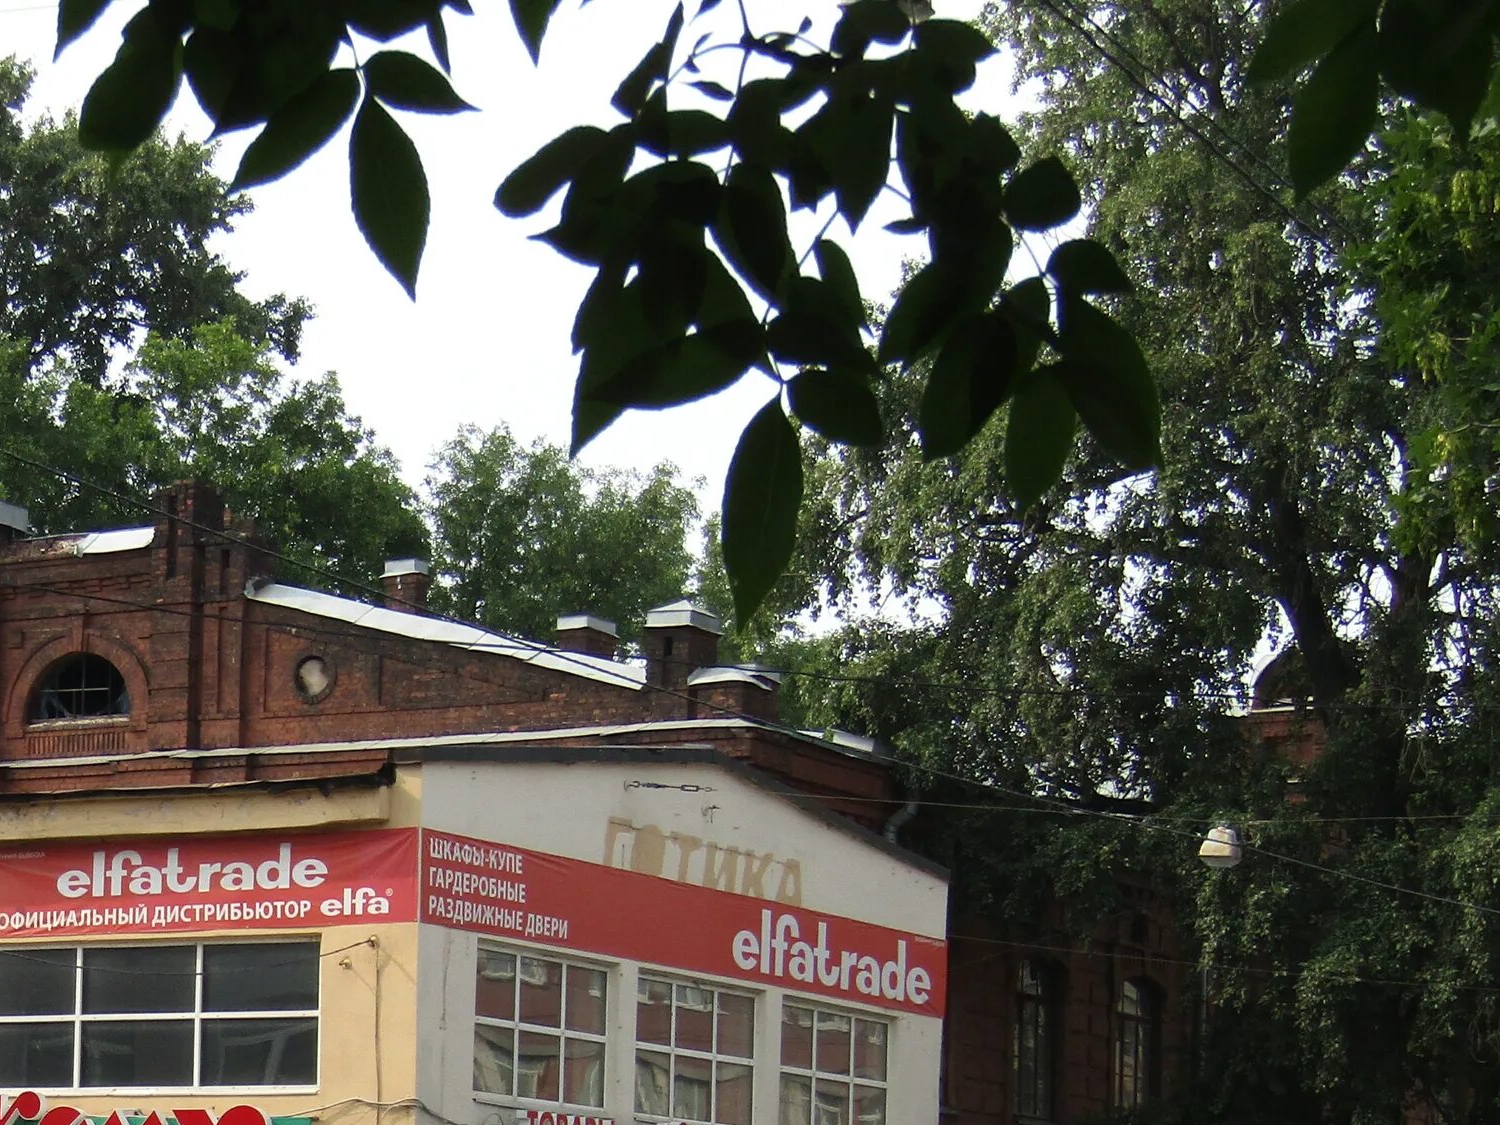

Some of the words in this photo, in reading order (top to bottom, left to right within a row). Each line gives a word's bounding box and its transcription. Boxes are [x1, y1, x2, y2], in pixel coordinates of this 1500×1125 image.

[56, 842, 328, 898] elfatrade
[429, 837, 523, 875] ШКАФЫ-КУПЕ
[429, 866, 526, 903] ГАРДЕРОБНЫЕ
[151, 899, 312, 927] ДИСТРИБЬЮТОР
[428, 895, 524, 931] РАЗДВИЖНЫЕ
[524, 912, 569, 939] ДВЕРИ
[732, 908, 932, 1005] elfatrade
